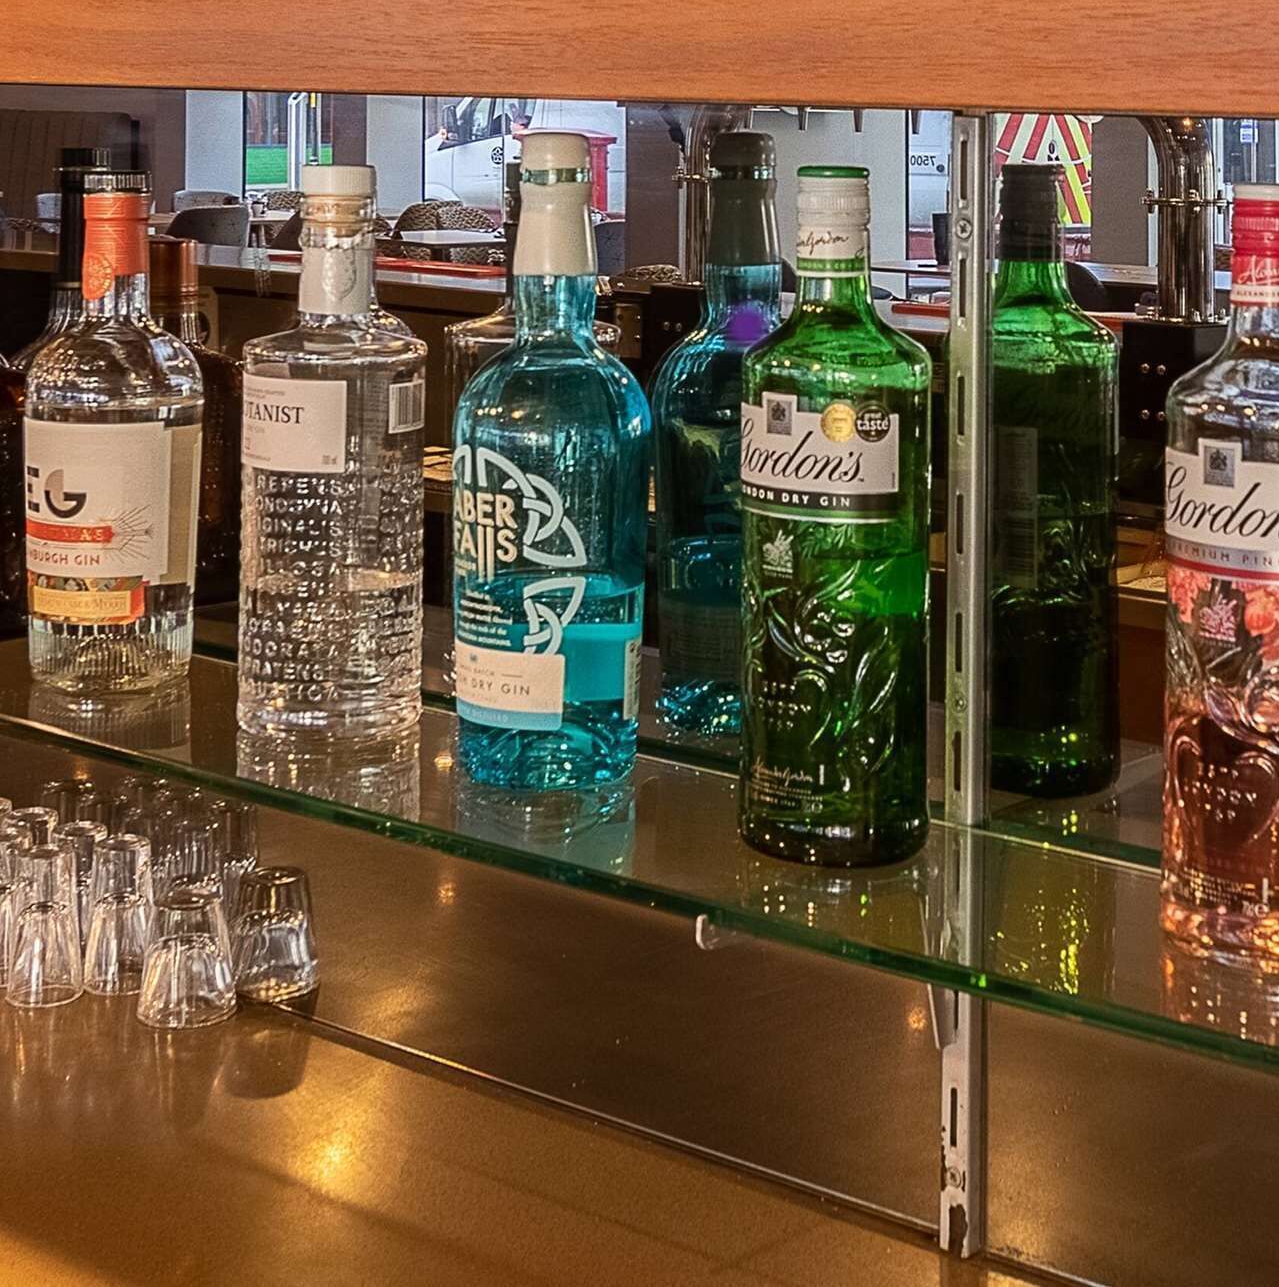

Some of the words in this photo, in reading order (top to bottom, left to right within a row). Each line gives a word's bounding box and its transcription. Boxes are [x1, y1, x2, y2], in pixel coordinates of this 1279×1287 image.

[856, 417, 889, 431] taste
[781, 492, 810, 505] DRY
[819, 495, 852, 507] GIN
[454, 487, 518, 529] ABER
[74, 553, 101, 565] GIN
[471, 678, 493, 692] DRY
[500, 682, 531, 697] GIN
